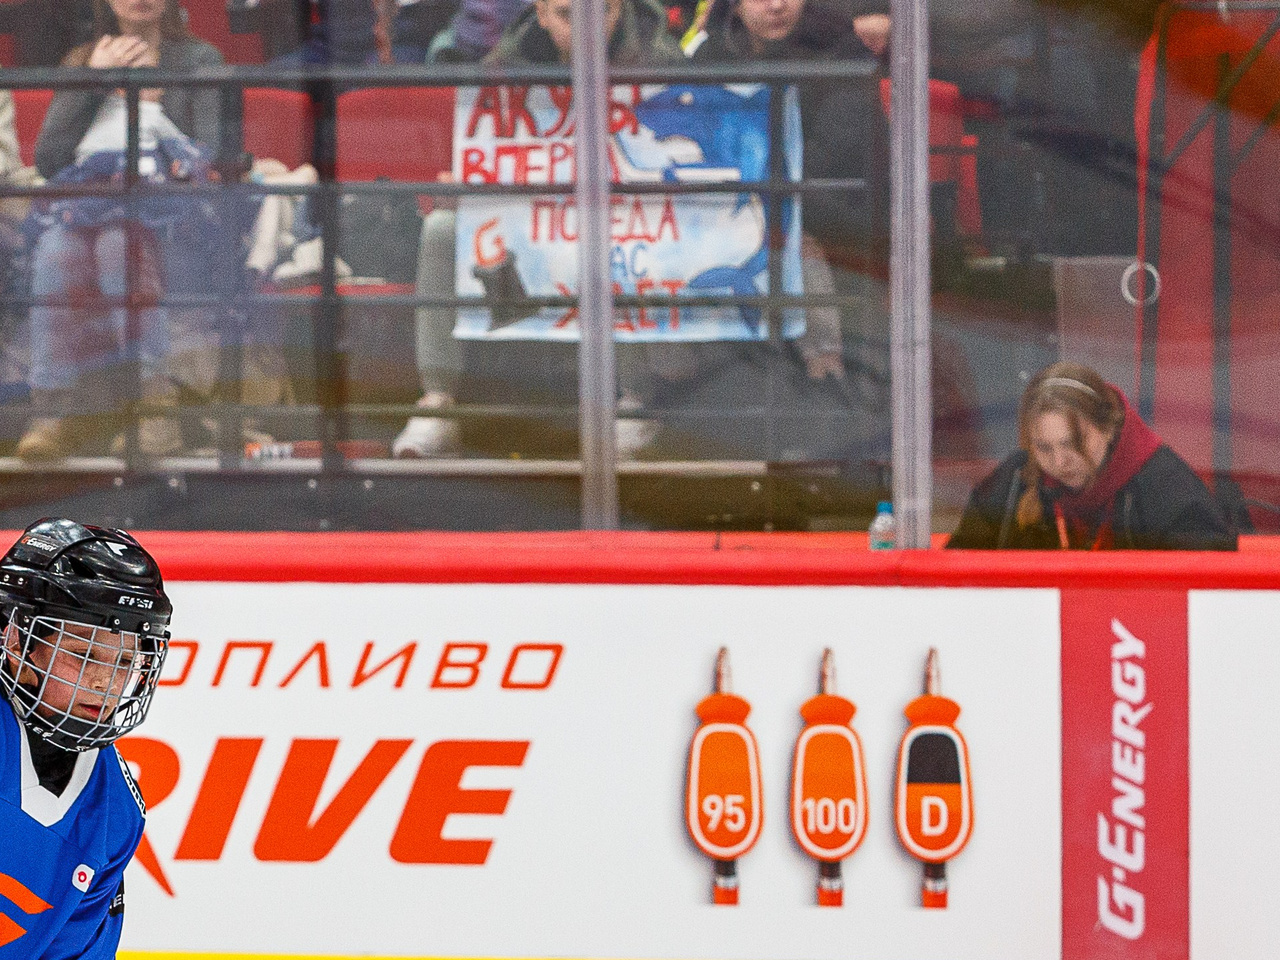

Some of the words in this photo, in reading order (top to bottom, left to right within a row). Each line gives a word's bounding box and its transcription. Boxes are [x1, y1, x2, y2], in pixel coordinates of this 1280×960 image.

[531, 197, 681, 243] ПОЕДА
[156, 640, 564, 690] ОПЛИВО
[701, 793, 747, 833] 95
[802, 796, 856, 835] 100
[919, 796, 949, 836] D
